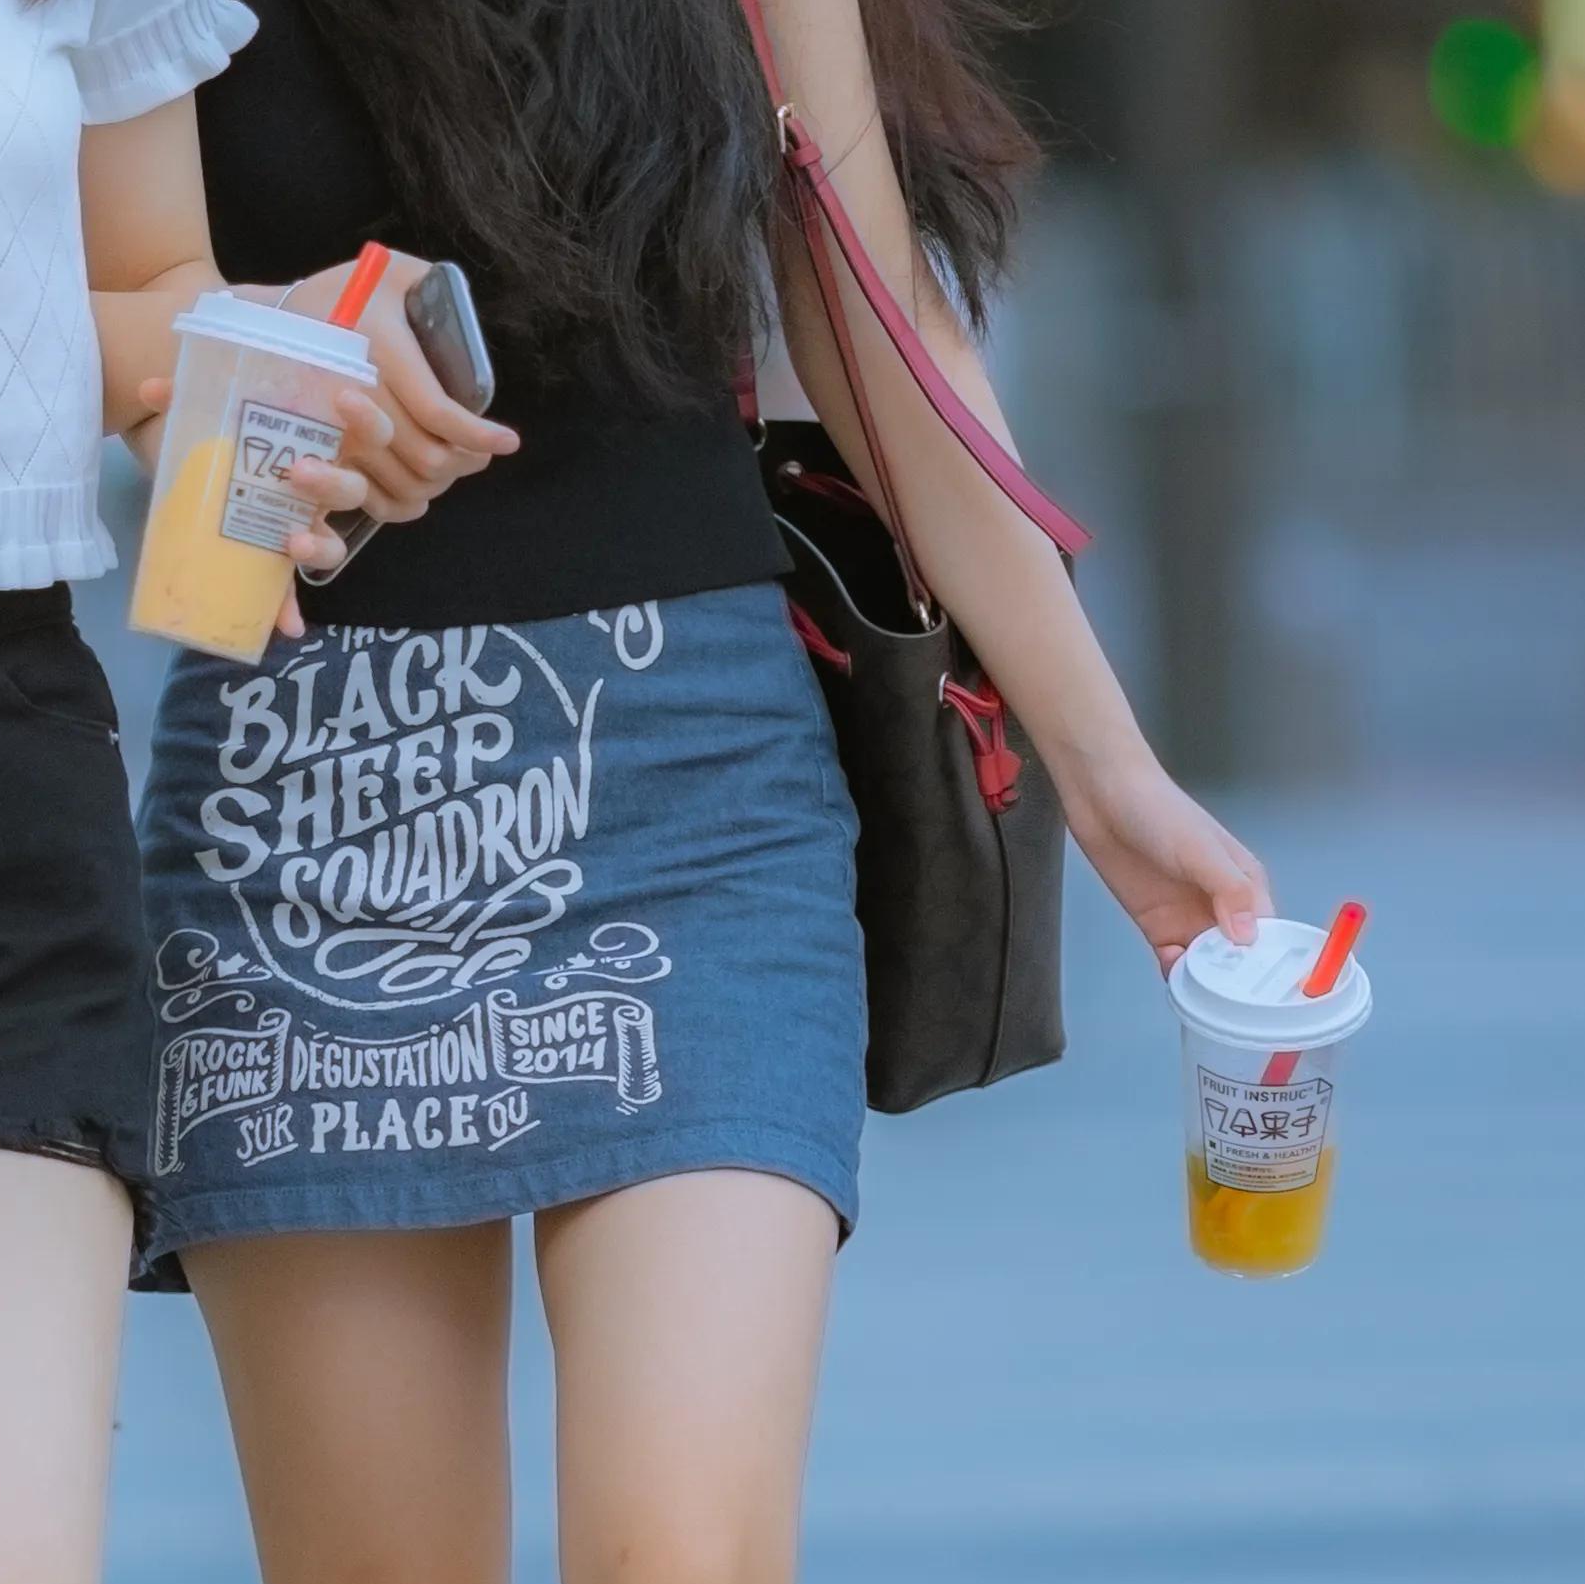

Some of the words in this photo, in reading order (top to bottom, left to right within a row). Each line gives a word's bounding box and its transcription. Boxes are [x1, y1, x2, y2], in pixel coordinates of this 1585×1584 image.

[247, 411, 291, 434] FRUIT
[218, 626, 522, 784] BLACK
[194, 713, 514, 882] SHEEP
[272, 678, 604, 948] SQUADRON
[509, 1001, 607, 1047] SINCE
[189, 1039, 271, 1079] ROCK
[512, 1036, 607, 1074] 2014
[1203, 1076, 1238, 1097] FRUIT
[236, 1103, 295, 1160] SUR
[309, 1094, 481, 1154] PLACE
[488, 1091, 528, 1138] OU
[1226, 1146, 1259, 1160] FRESH
